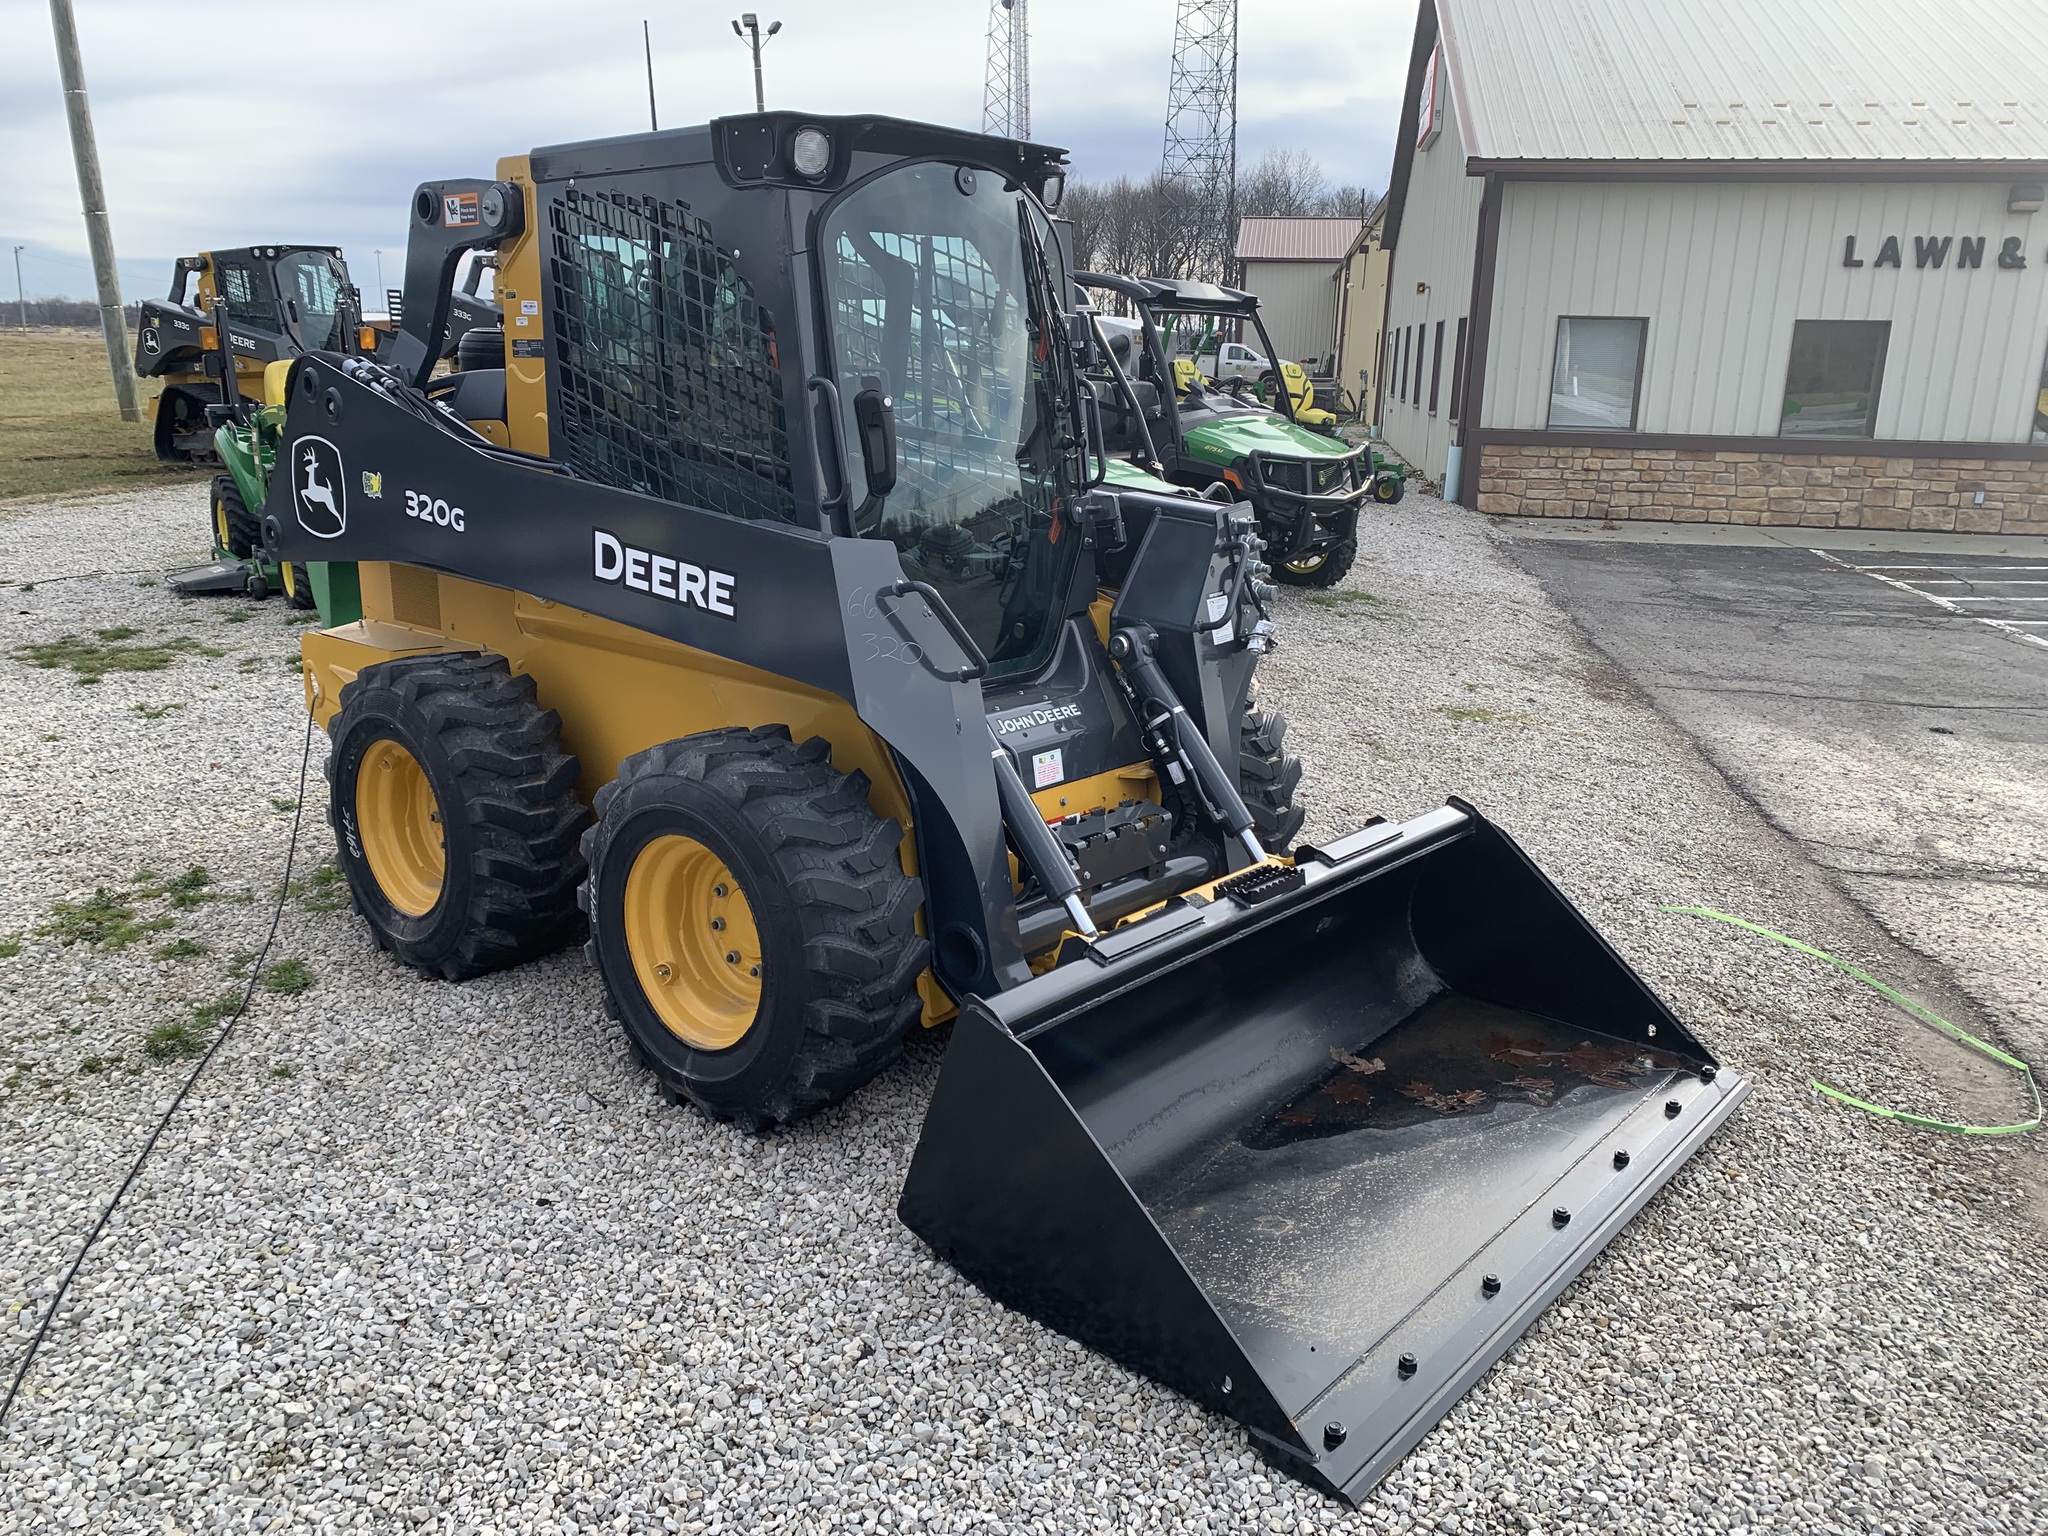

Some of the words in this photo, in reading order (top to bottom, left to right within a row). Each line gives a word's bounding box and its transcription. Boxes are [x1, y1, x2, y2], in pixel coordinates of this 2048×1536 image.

[1843, 235, 1986, 269] LAWN
[1998, 236, 2027, 269] &
[173, 319, 190, 331] 333G
[453, 308, 472, 321] 333G
[229, 332, 256, 350] EERE
[405, 490, 465, 532] 320G
[595, 531, 735, 616] DEERE
[861, 633, 924, 665] 320
[997, 714, 1036, 735] JOHN
[1032, 703, 1082, 725] DEERE
